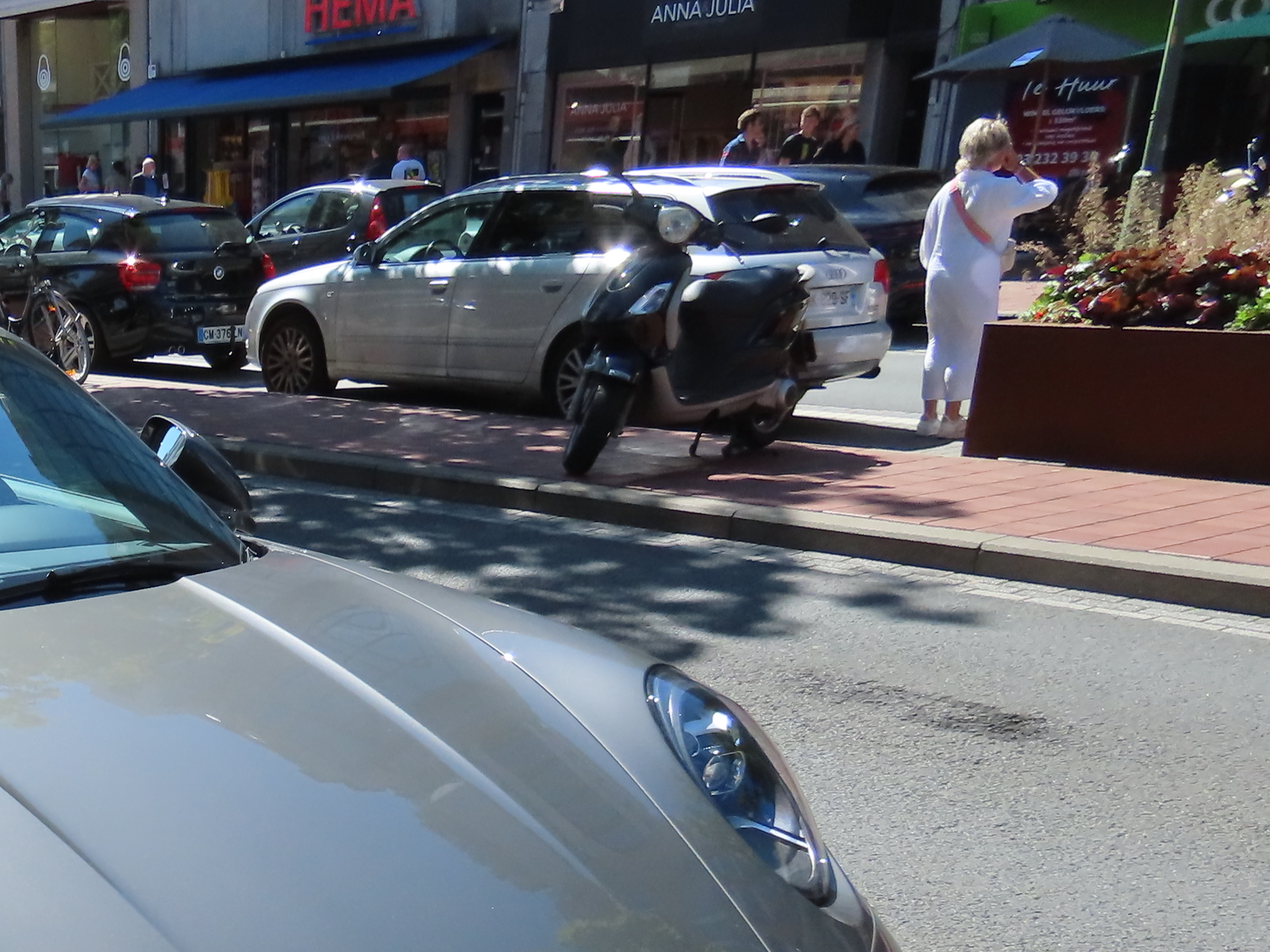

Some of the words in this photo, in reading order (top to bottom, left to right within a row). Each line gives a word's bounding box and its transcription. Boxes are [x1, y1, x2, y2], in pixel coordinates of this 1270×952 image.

[304, 0, 417, 33] HEMA
[651, 1, 702, 23] ANNA
[705, 0, 755, 17] JULIA
[1055, 76, 1118, 101] Huur
[1033, 152, 1059, 165] 232
[1061, 151, 1079, 164] 39
[203, 326, 244, 341] CM-376LN
